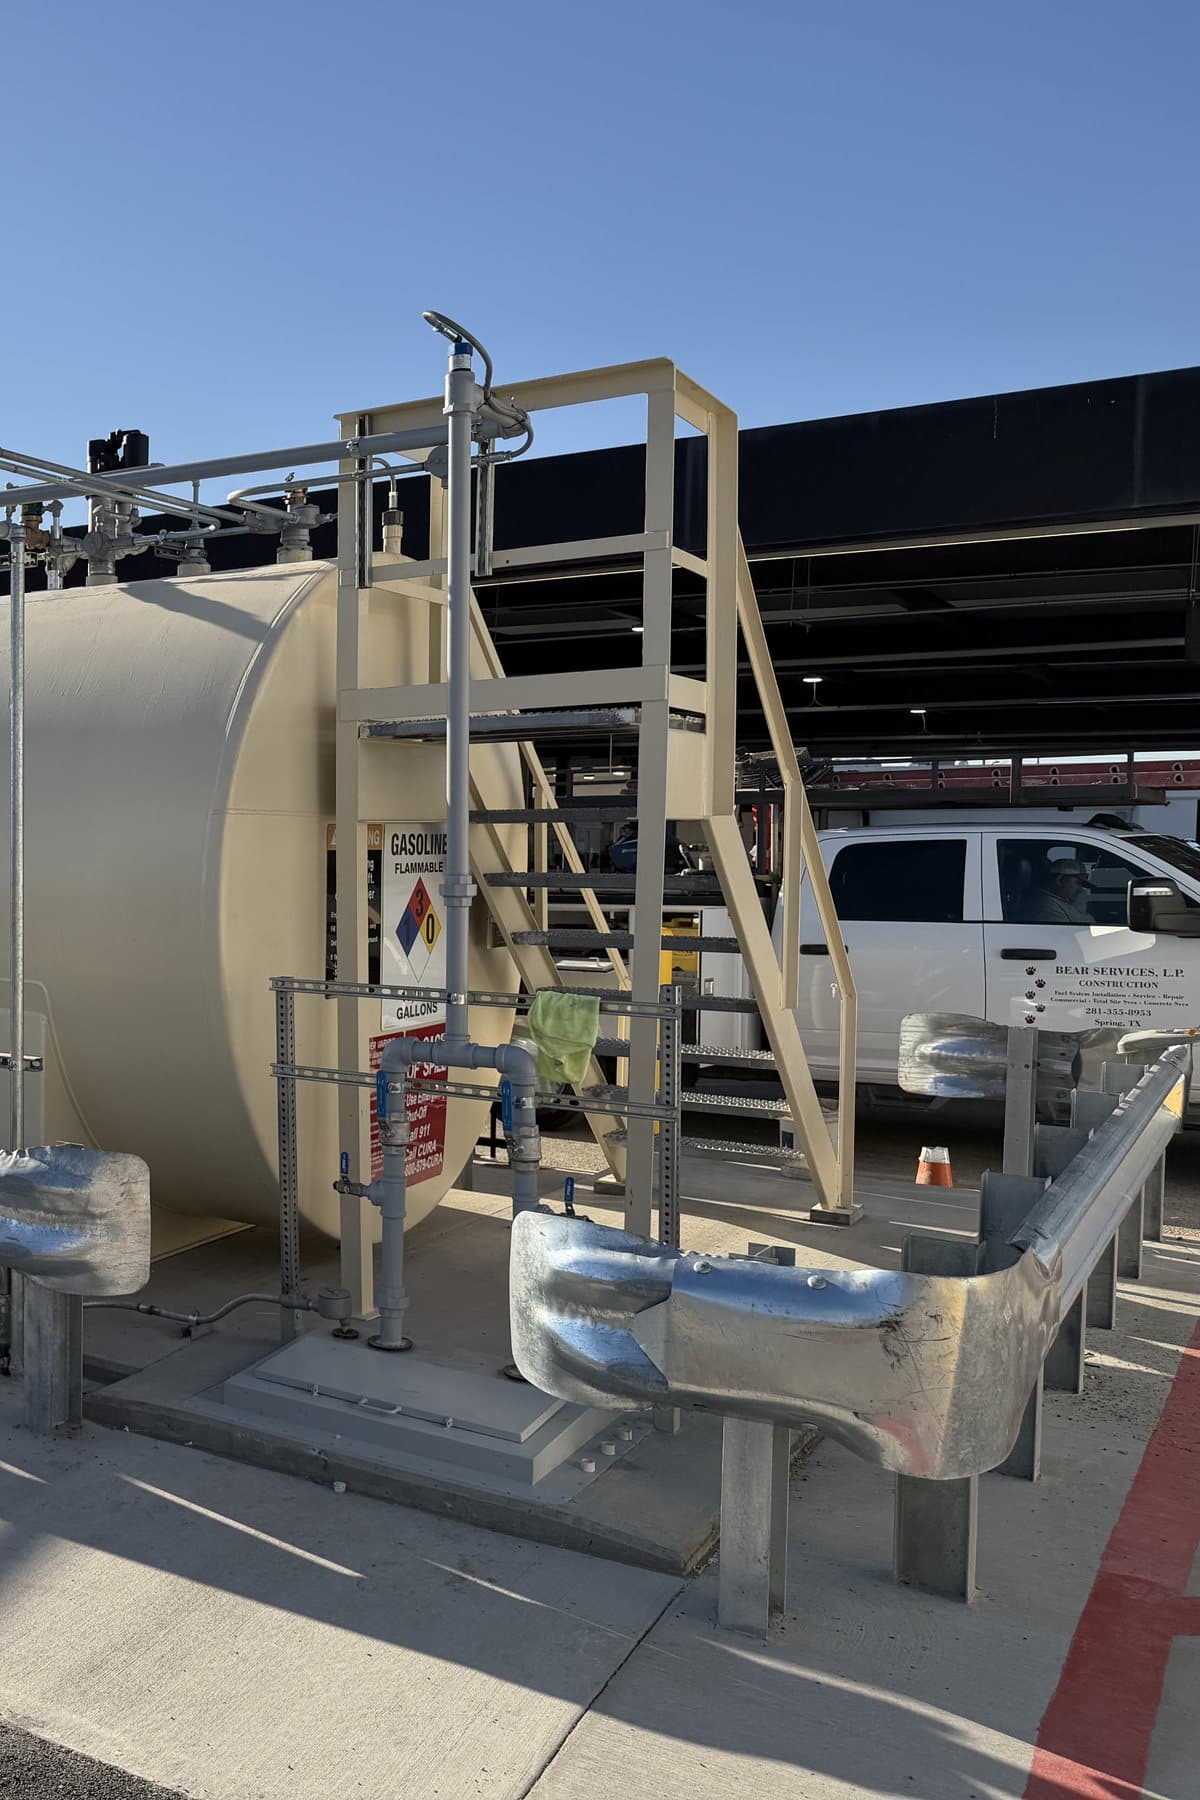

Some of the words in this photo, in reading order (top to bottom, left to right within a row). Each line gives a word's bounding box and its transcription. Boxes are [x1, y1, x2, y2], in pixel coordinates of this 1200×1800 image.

[391, 833, 447, 856] GASOLINE
[395, 862, 443, 874] FLAMMABLE
[415, 889, 424, 917] 3
[426, 913, 435, 944] 0
[1055, 966, 1089, 975] BEAR
[1093, 967, 1159, 978] SERVICES,
[1163, 968, 1185, 978] L.P.
[1079, 979, 1159, 989] CONSTRUCTION
[1092, 991, 1126, 999] Installation
[396, 1002, 438, 1020] GALLONS
[1085, 1007, 1152, 1017] 281-355-8953
[1094, 1018, 1125, 1028] Spring,
[1128, 1019, 1142, 1028] TX
[409, 1127, 418, 1142] all
[419, 1122, 431, 1139] 911
[417, 1139, 437, 1158] CURA
